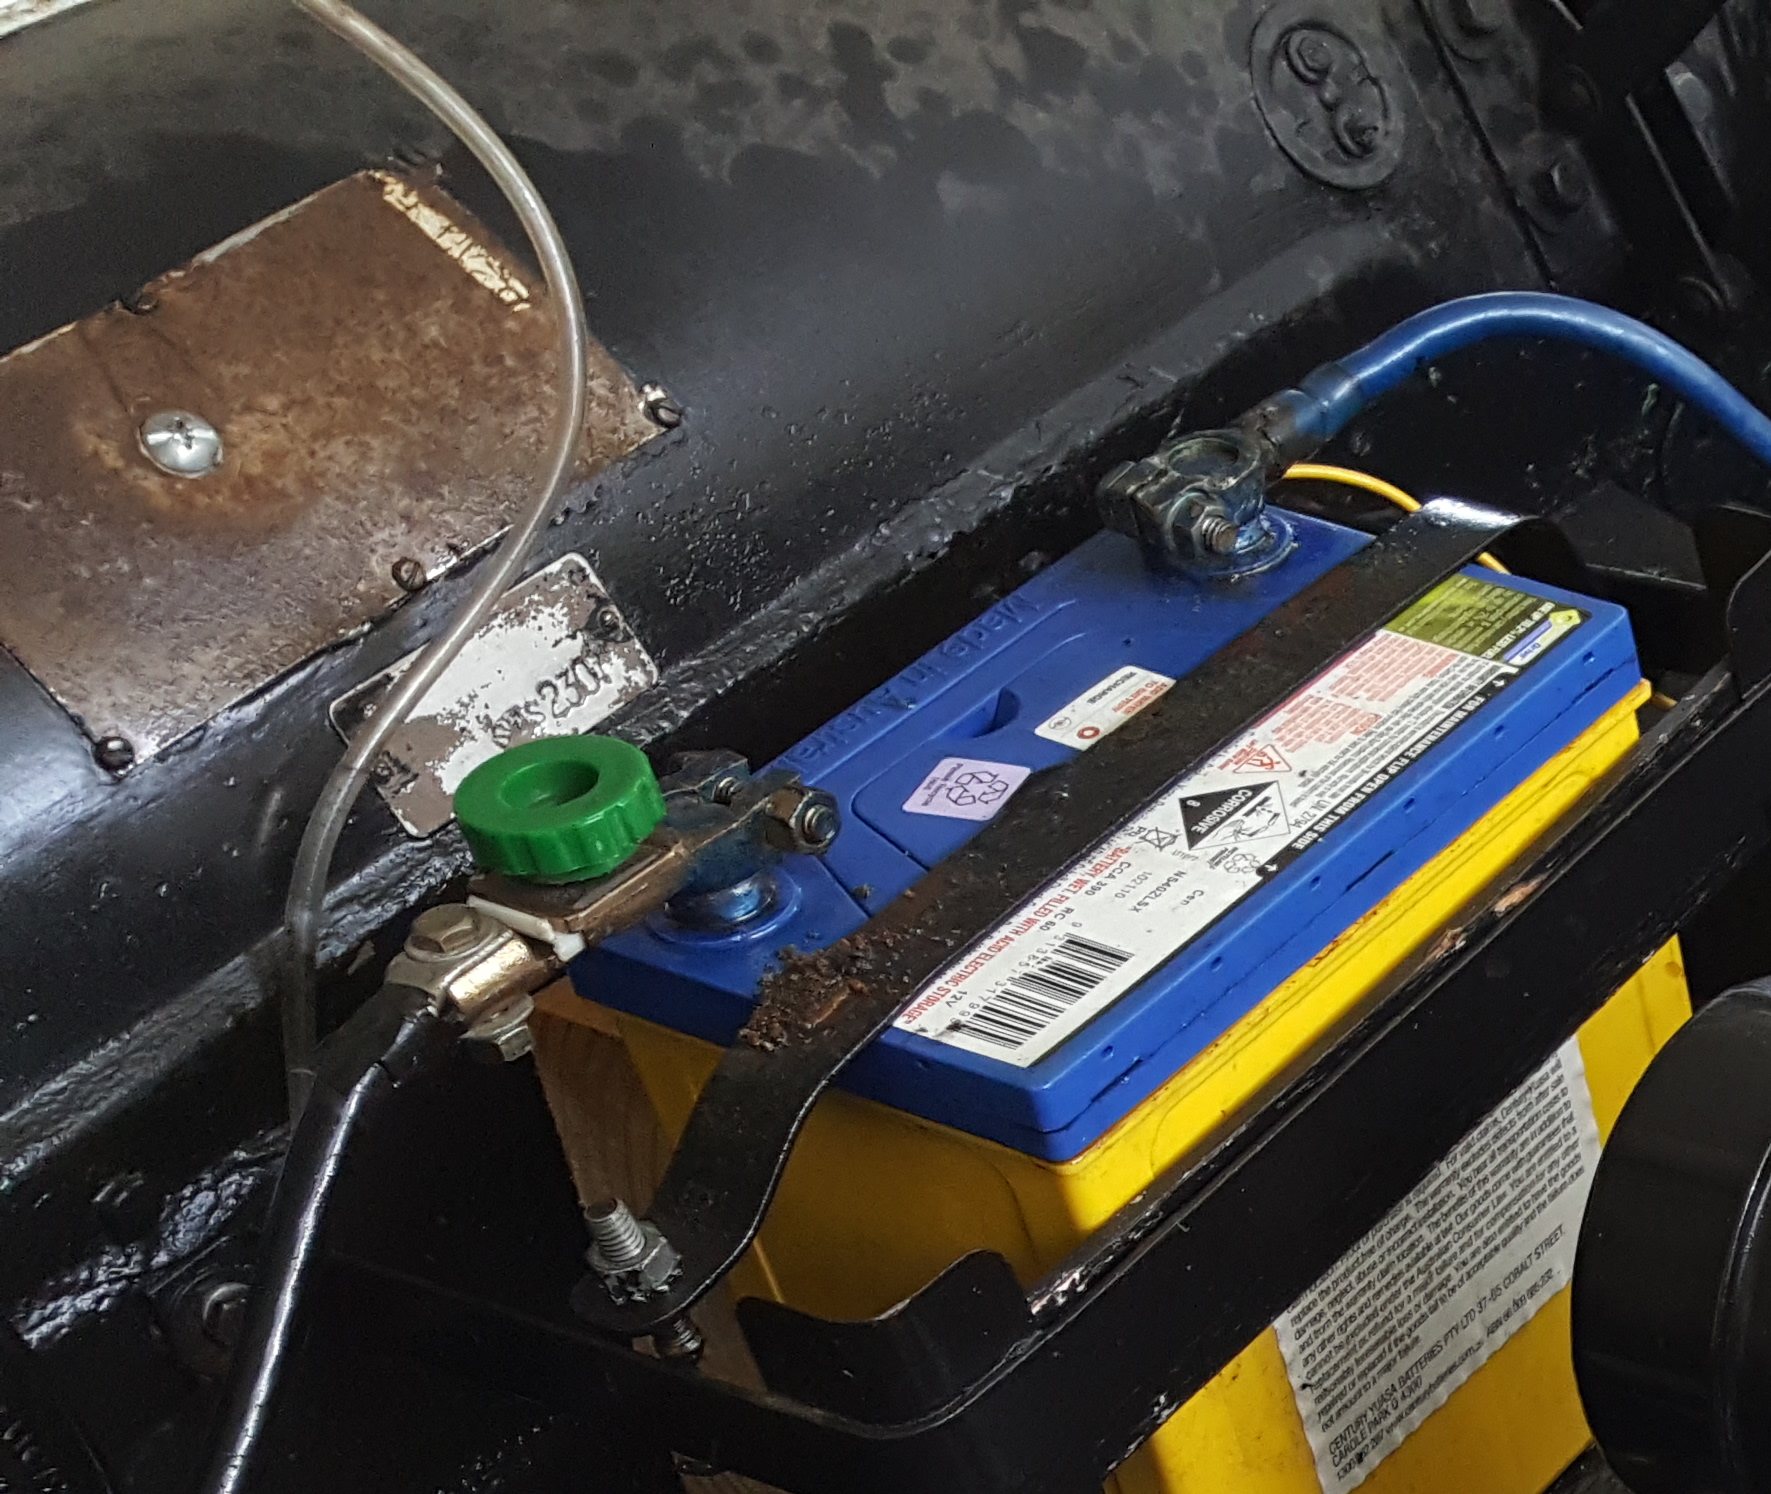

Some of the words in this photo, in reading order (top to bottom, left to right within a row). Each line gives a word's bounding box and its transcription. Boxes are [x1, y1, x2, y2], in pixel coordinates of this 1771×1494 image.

[1461, 692, 1485, 714] FOR
[1403, 706, 1466, 761] MAINTENANCE
[1385, 753, 1409, 776] FLIP
[1359, 769, 1390, 797] OPEN
[1188, 787, 1255, 835] CORROSIVE
[1333, 789, 1365, 818] FROM
[1312, 810, 1339, 835] THIS
[1290, 826, 1319, 852] SIDE
[1102, 860, 1134, 881] CCA
[1030, 892, 1070, 918] FILLED
[1051, 905, 1075, 921] RC
[1007, 915, 1042, 937] WITH
[985, 934, 1018, 954] ACID
[943, 951, 996, 988] ELECTRIC
[939, 988, 970, 1008] 12V
[1328, 1409, 1368, 1457] CENTURY
[1397, 1337, 1443, 1389] BATTERIES
[1459, 1305, 1476, 1330] LTD
[1502, 1251, 1533, 1291] COBALT
[1331, 1426, 1367, 1469] CAROLE
[1367, 1402, 1391, 1434] PARK
